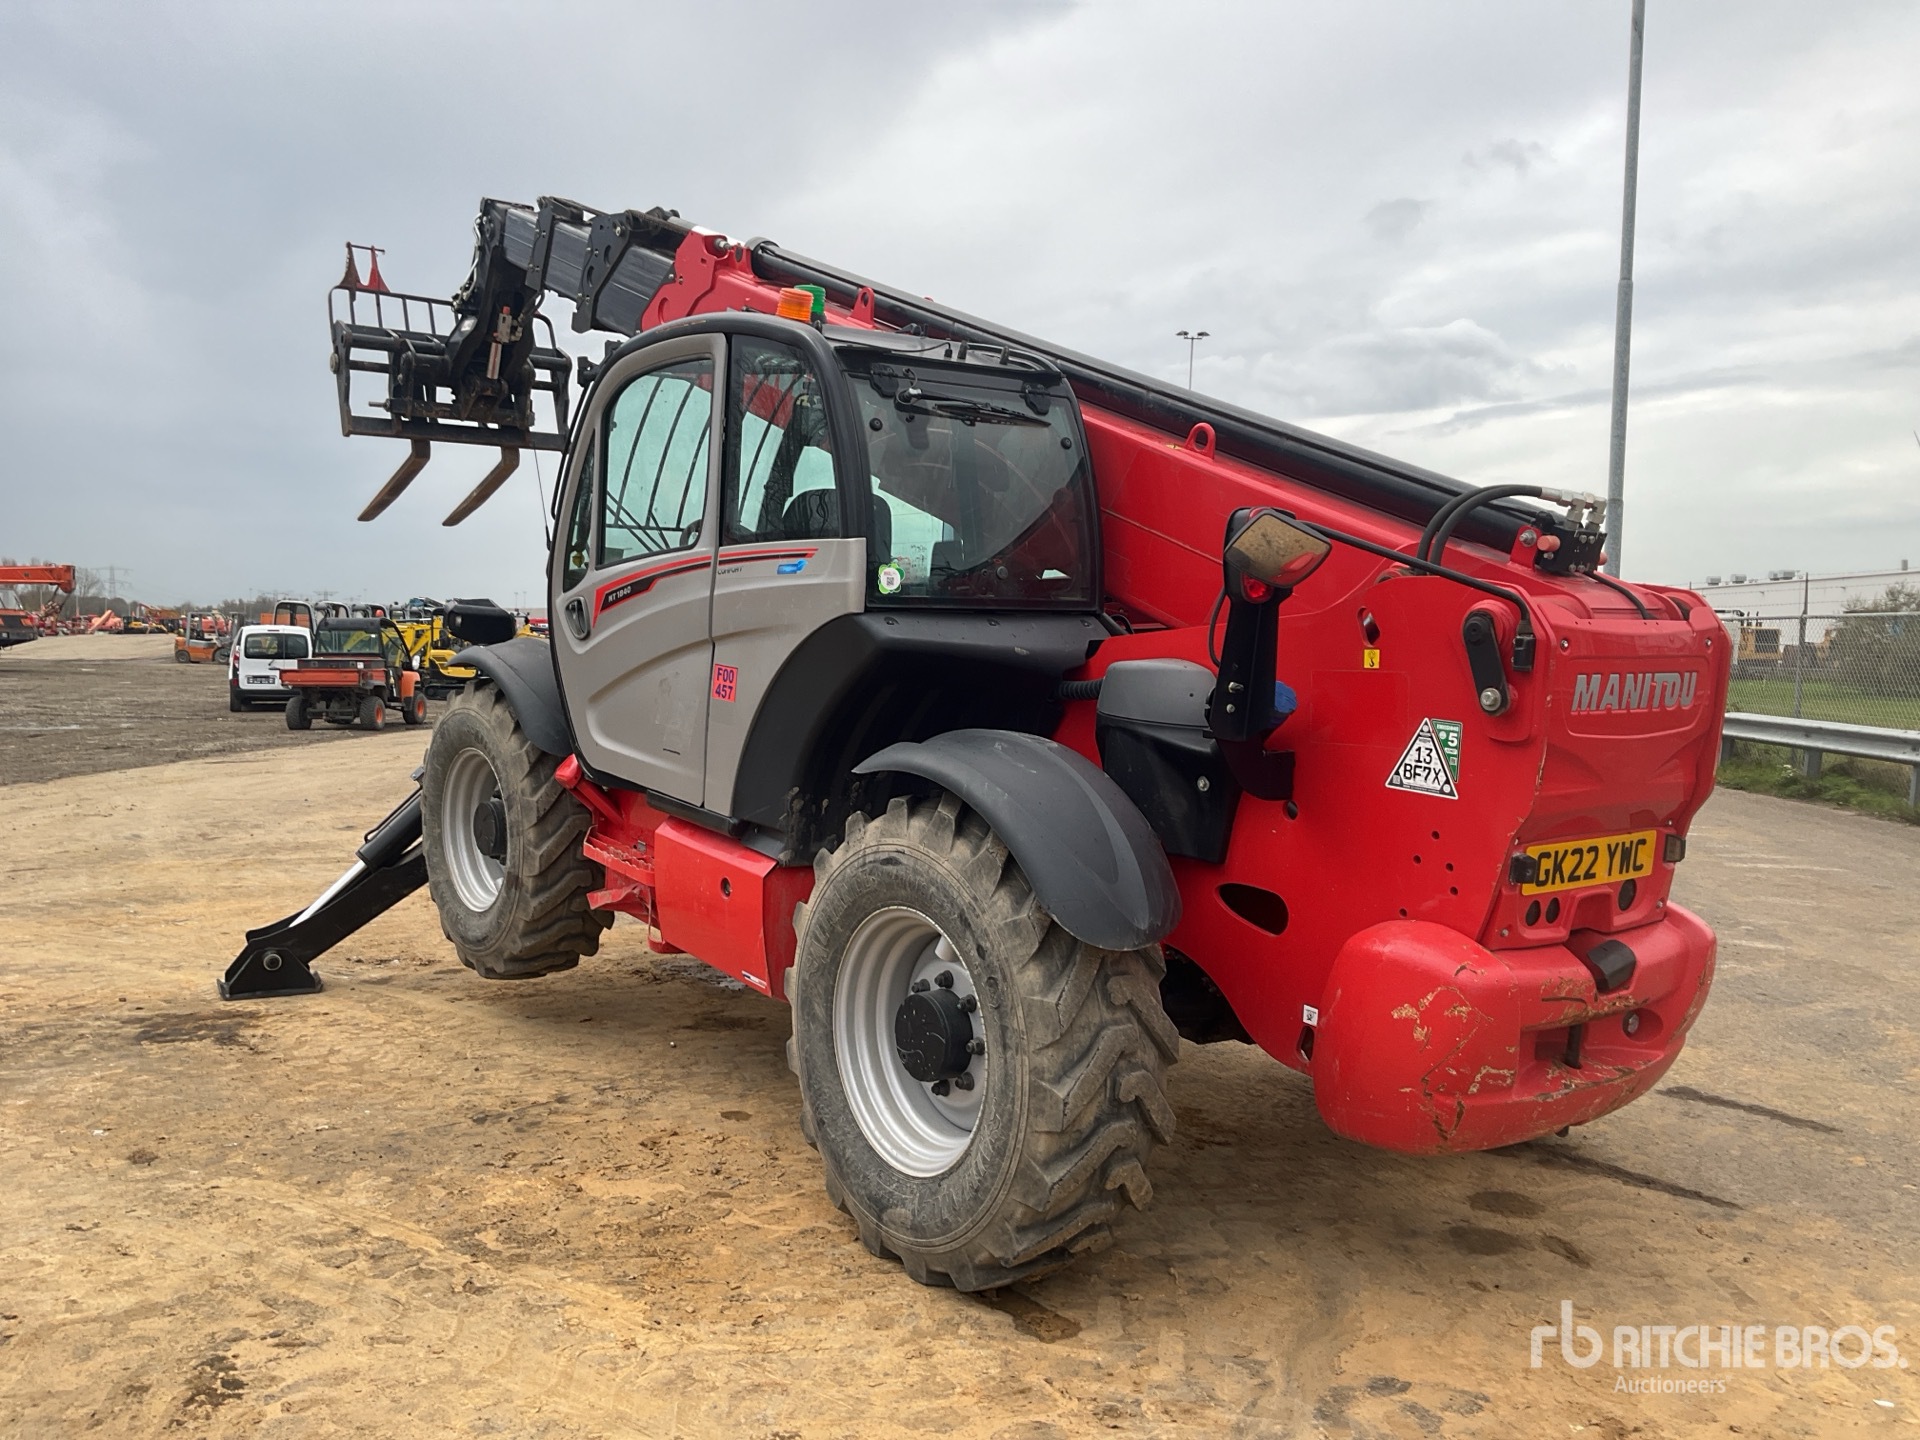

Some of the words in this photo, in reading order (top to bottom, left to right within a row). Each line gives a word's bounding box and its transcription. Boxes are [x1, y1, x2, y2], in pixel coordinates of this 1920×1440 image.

[715, 683, 733, 699] 457
[1571, 671, 1698, 713] MANITOU
[1447, 732, 1458, 747] 5
[1414, 746, 1433, 764] 13
[1403, 763, 1441, 786] BF7X
[1535, 845, 1600, 888] GK22
[1606, 838, 1648, 877] YWC
